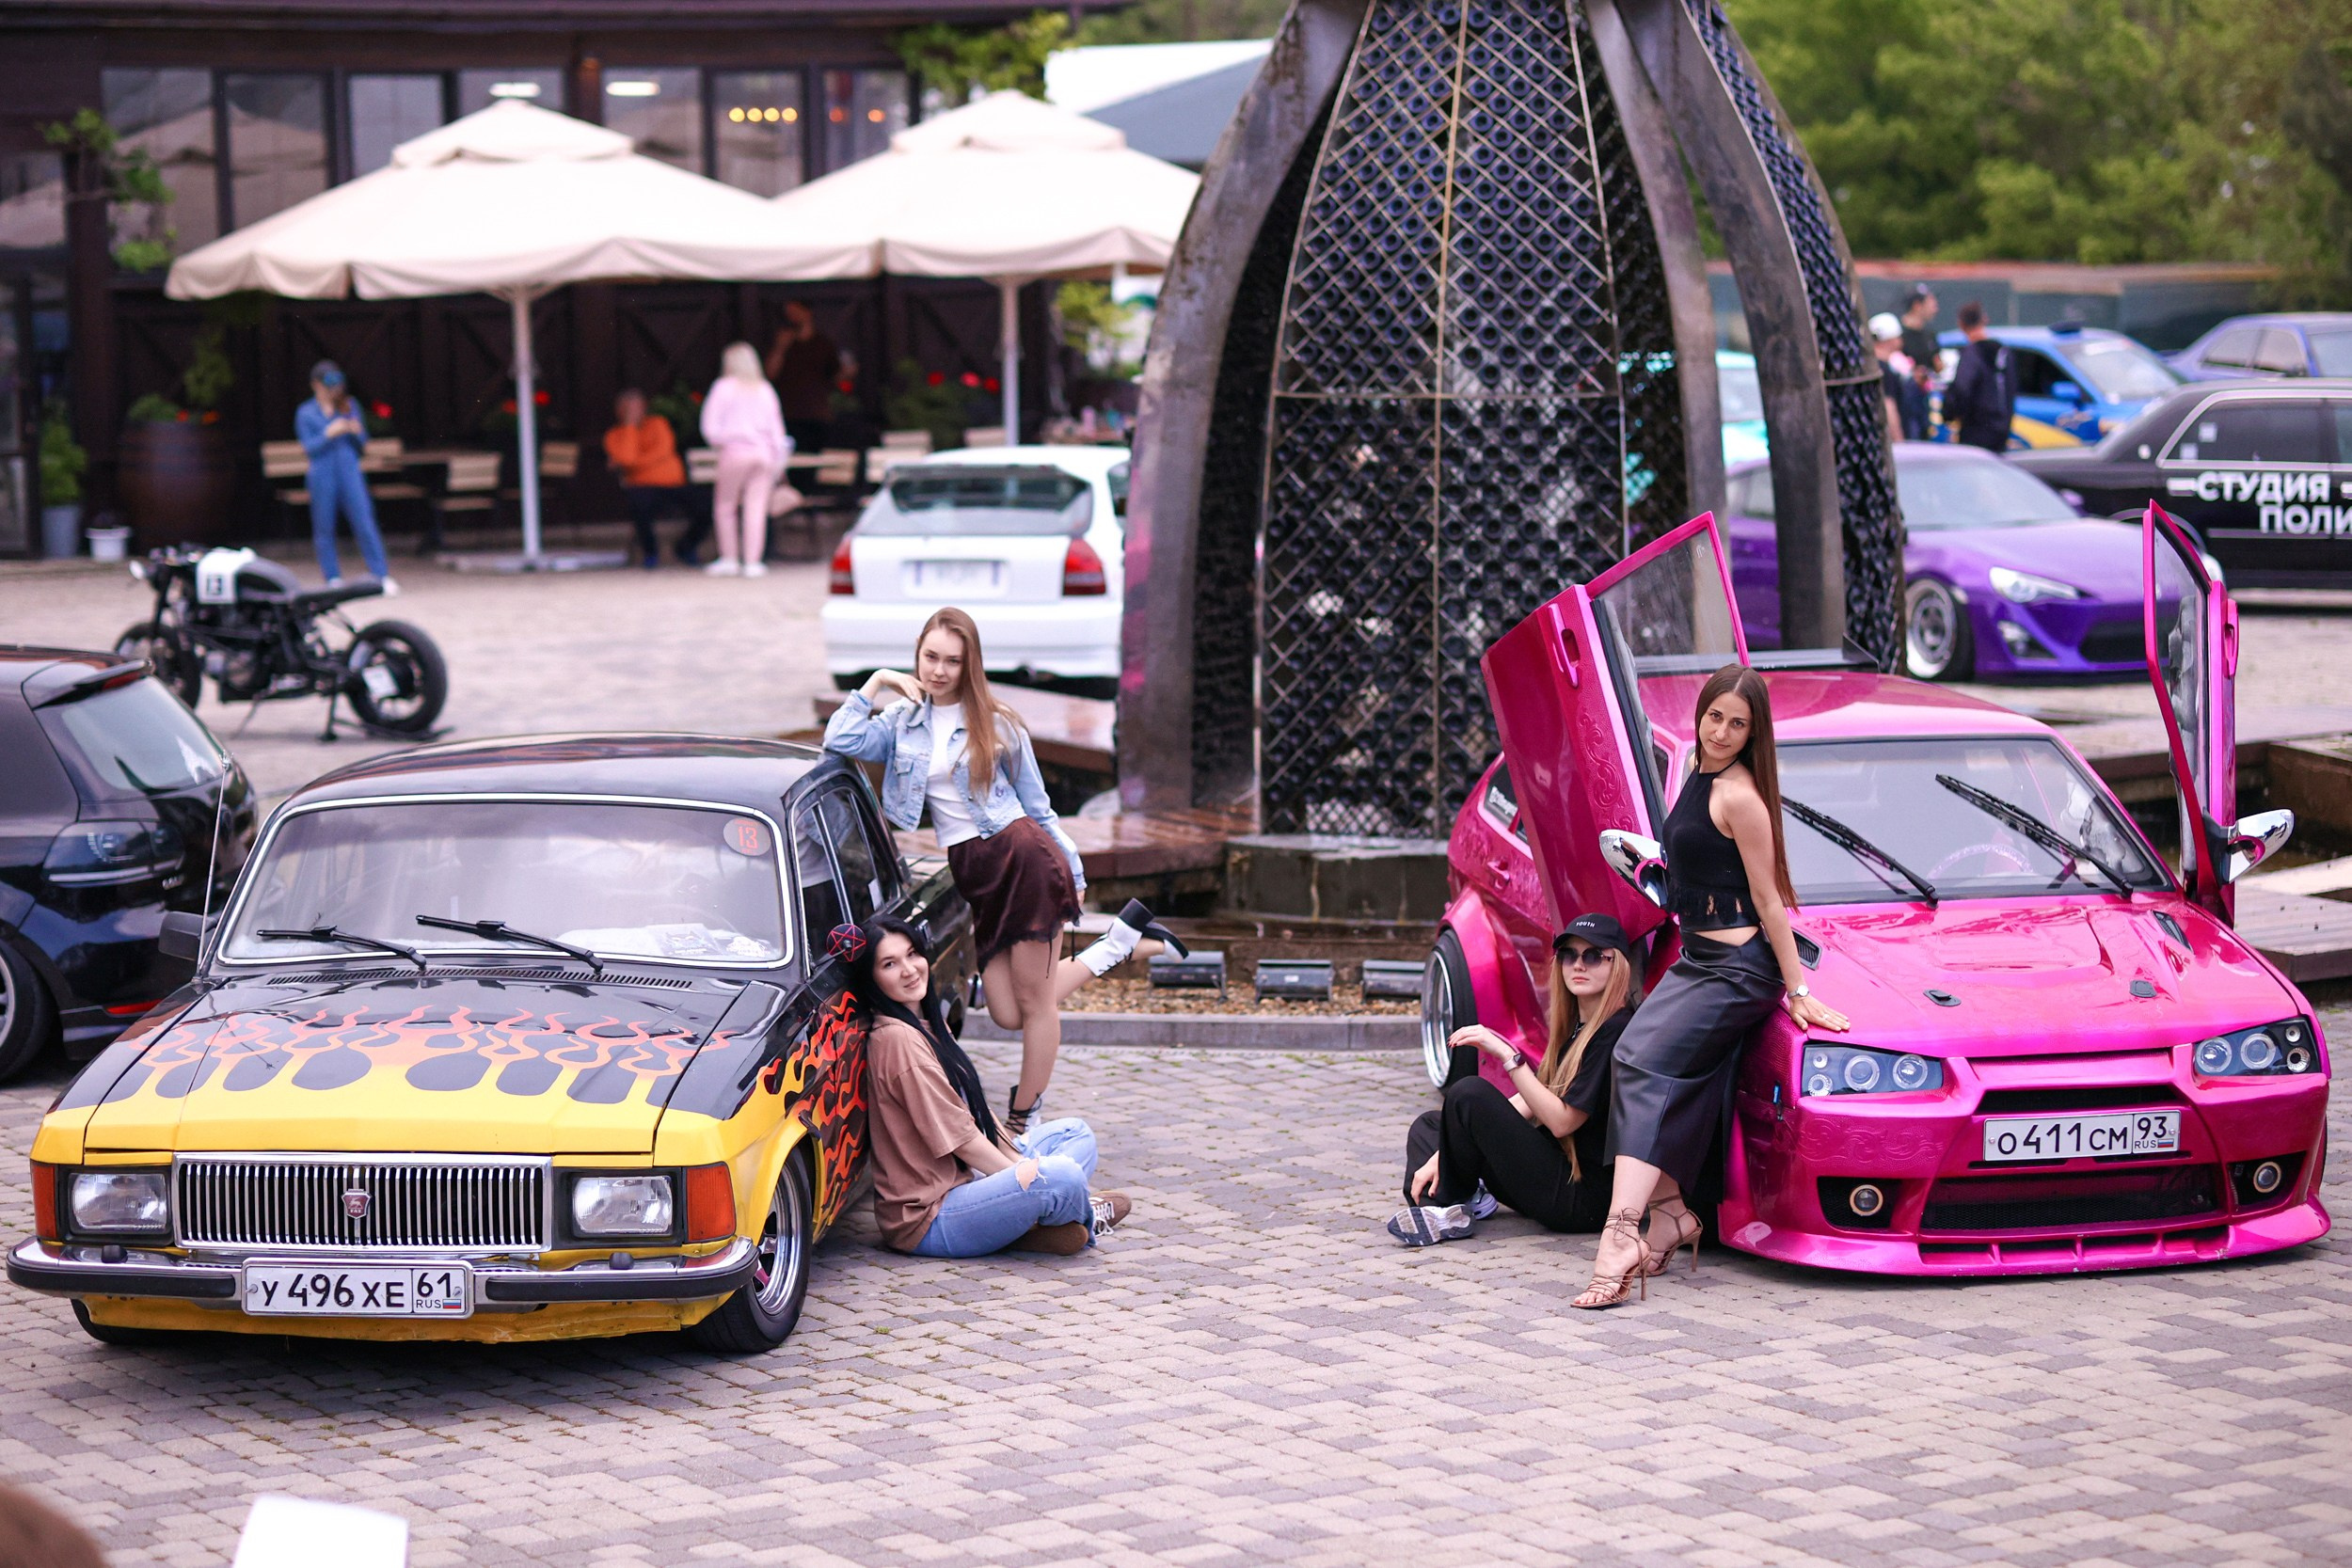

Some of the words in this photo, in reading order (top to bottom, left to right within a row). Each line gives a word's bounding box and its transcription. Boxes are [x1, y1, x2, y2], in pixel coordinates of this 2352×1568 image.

[2197, 471, 2331, 505] СТУДИЯ
[738, 826, 758, 849] 13
[2137, 1116, 2168, 1140] 93
[2134, 1139, 2157, 1149] RUS
[417, 1272, 452, 1298] 61
[416, 1299, 441, 1308] RUS
